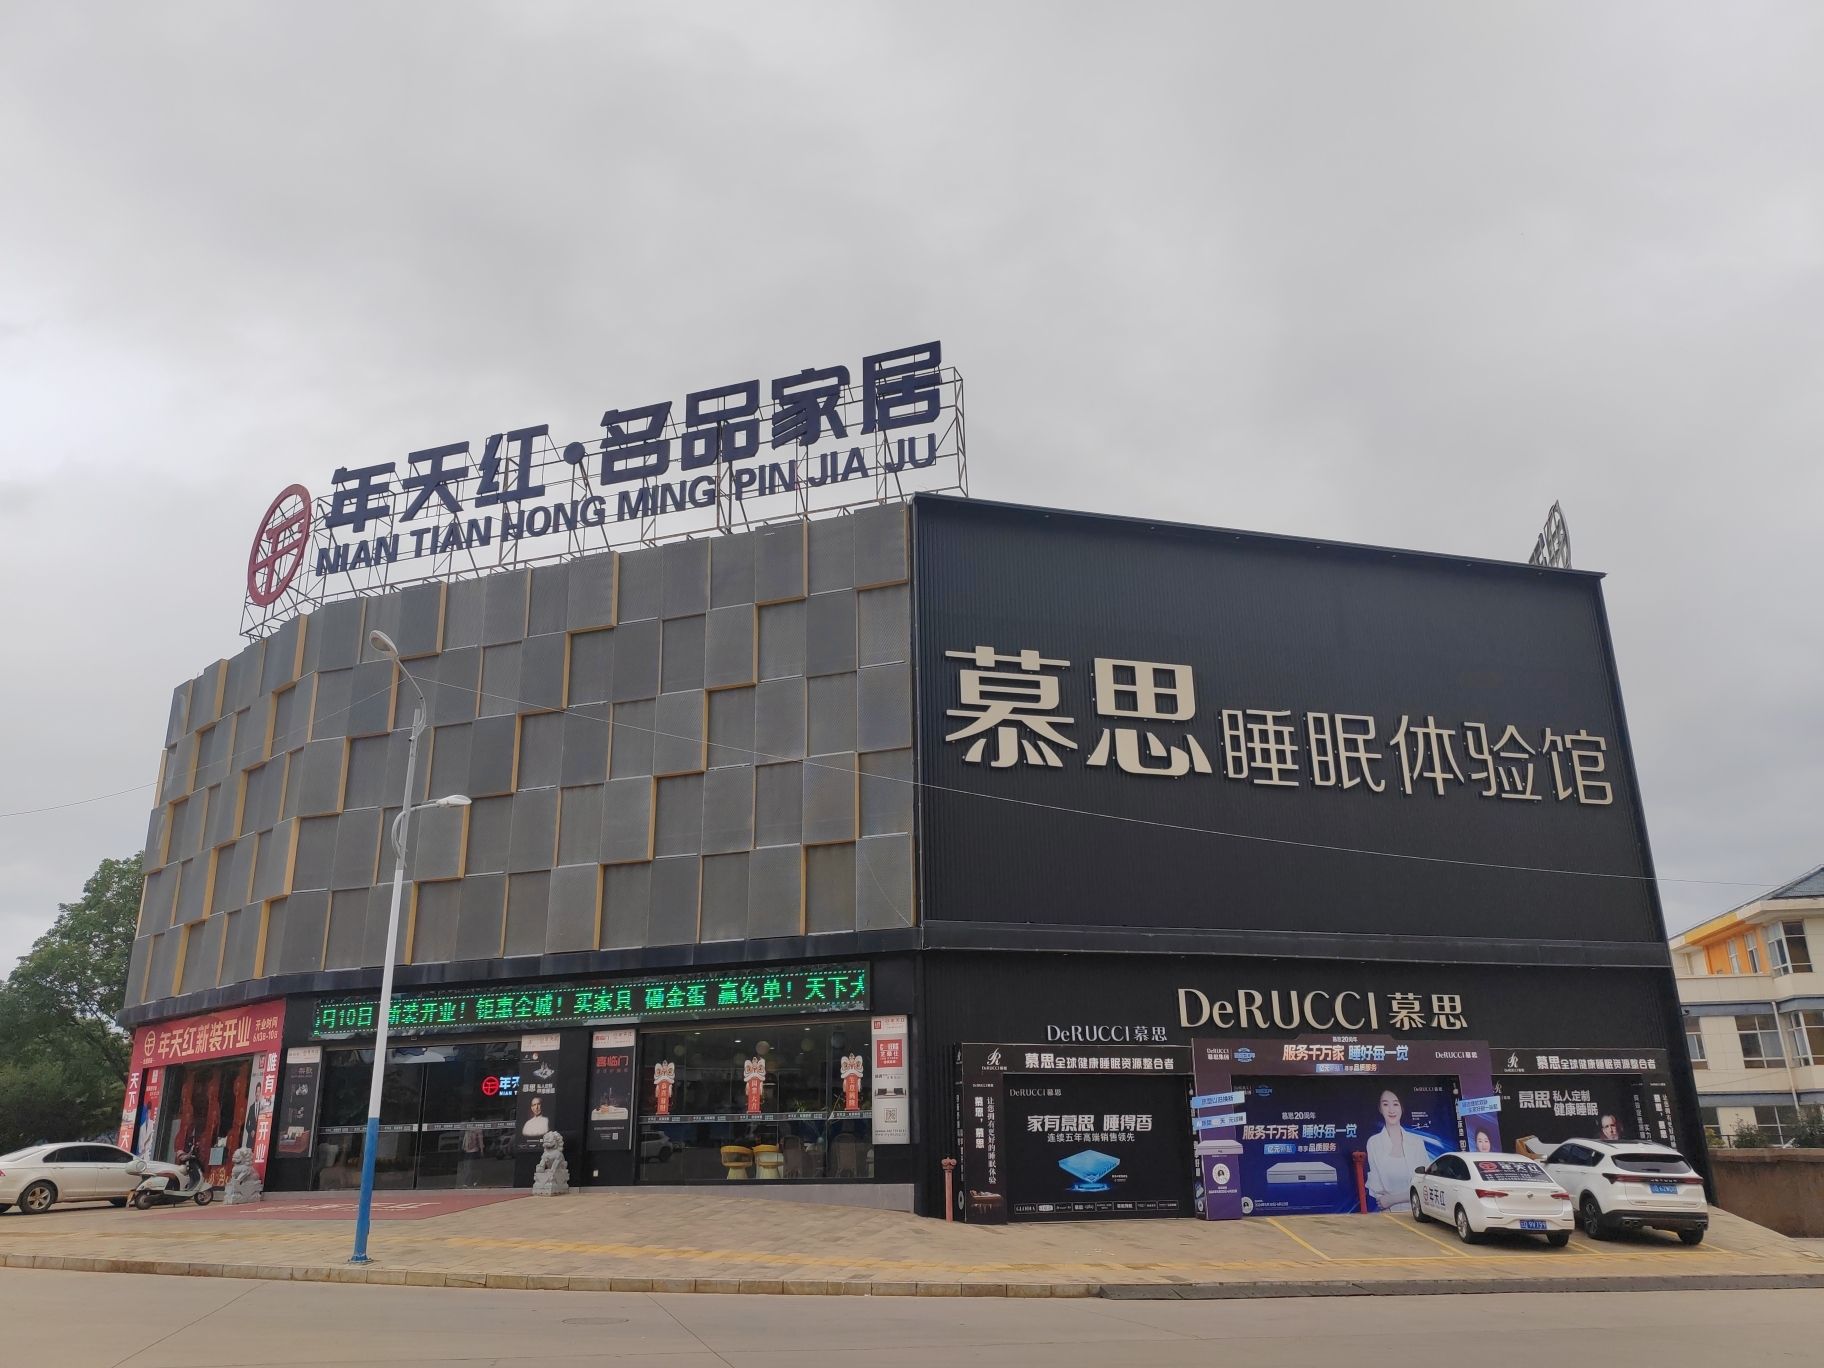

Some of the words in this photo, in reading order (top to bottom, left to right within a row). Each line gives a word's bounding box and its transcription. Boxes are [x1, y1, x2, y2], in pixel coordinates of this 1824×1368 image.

[317, 533, 399, 576] NIAN
[410, 515, 493, 558] TIAN
[501, 495, 606, 543] HONG
[617, 474, 717, 522] MING
[735, 459, 797, 501] PIN
[808, 446, 869, 488] JIA
[885, 432, 937, 474] JU
[945, 645, 1213, 778] 慕思
[1221, 708, 1613, 806] 睡眠体验馆
[644, 985, 706, 1009] 砸金蛋
[1177, 987, 1379, 1032] DeRUCCI
[1386, 992, 1469, 1032] 慕思
[158, 1016, 251, 1059] 年天红新装开业
[1047, 1025, 1130, 1042] DeRUCCI
[1134, 1026, 1168, 1042] 慕思
[1024, 1052, 1175, 1071] 慕思全球健康睡眠资源整合者
[1282, 1044, 1345, 1062] 服务千万家
[1348, 1044, 1409, 1061] 睡好每一觉
[1536, 1055, 1657, 1071] 慕思全球健康睡眠资源整合者
[129, 1072, 140, 1108] 天下
[1009, 1088, 1046, 1097] DeRUCCI
[1518, 1090, 1552, 1109] 慕思
[1552, 1089, 1591, 1102] 私人定制
[1553, 1102, 1599, 1117] 健康睡眠
[1027, 1114, 1095, 1133] 家有慕思
[1103, 1114, 1153, 1132] 睡得香
[1242, 1124, 1299, 1141] 服务千万家
[1302, 1123, 1358, 1139] 睡好每一觉
[254, 1121, 269, 1163] 开业
[1047, 1132, 1136, 1143] 连续五年高端销售领先
